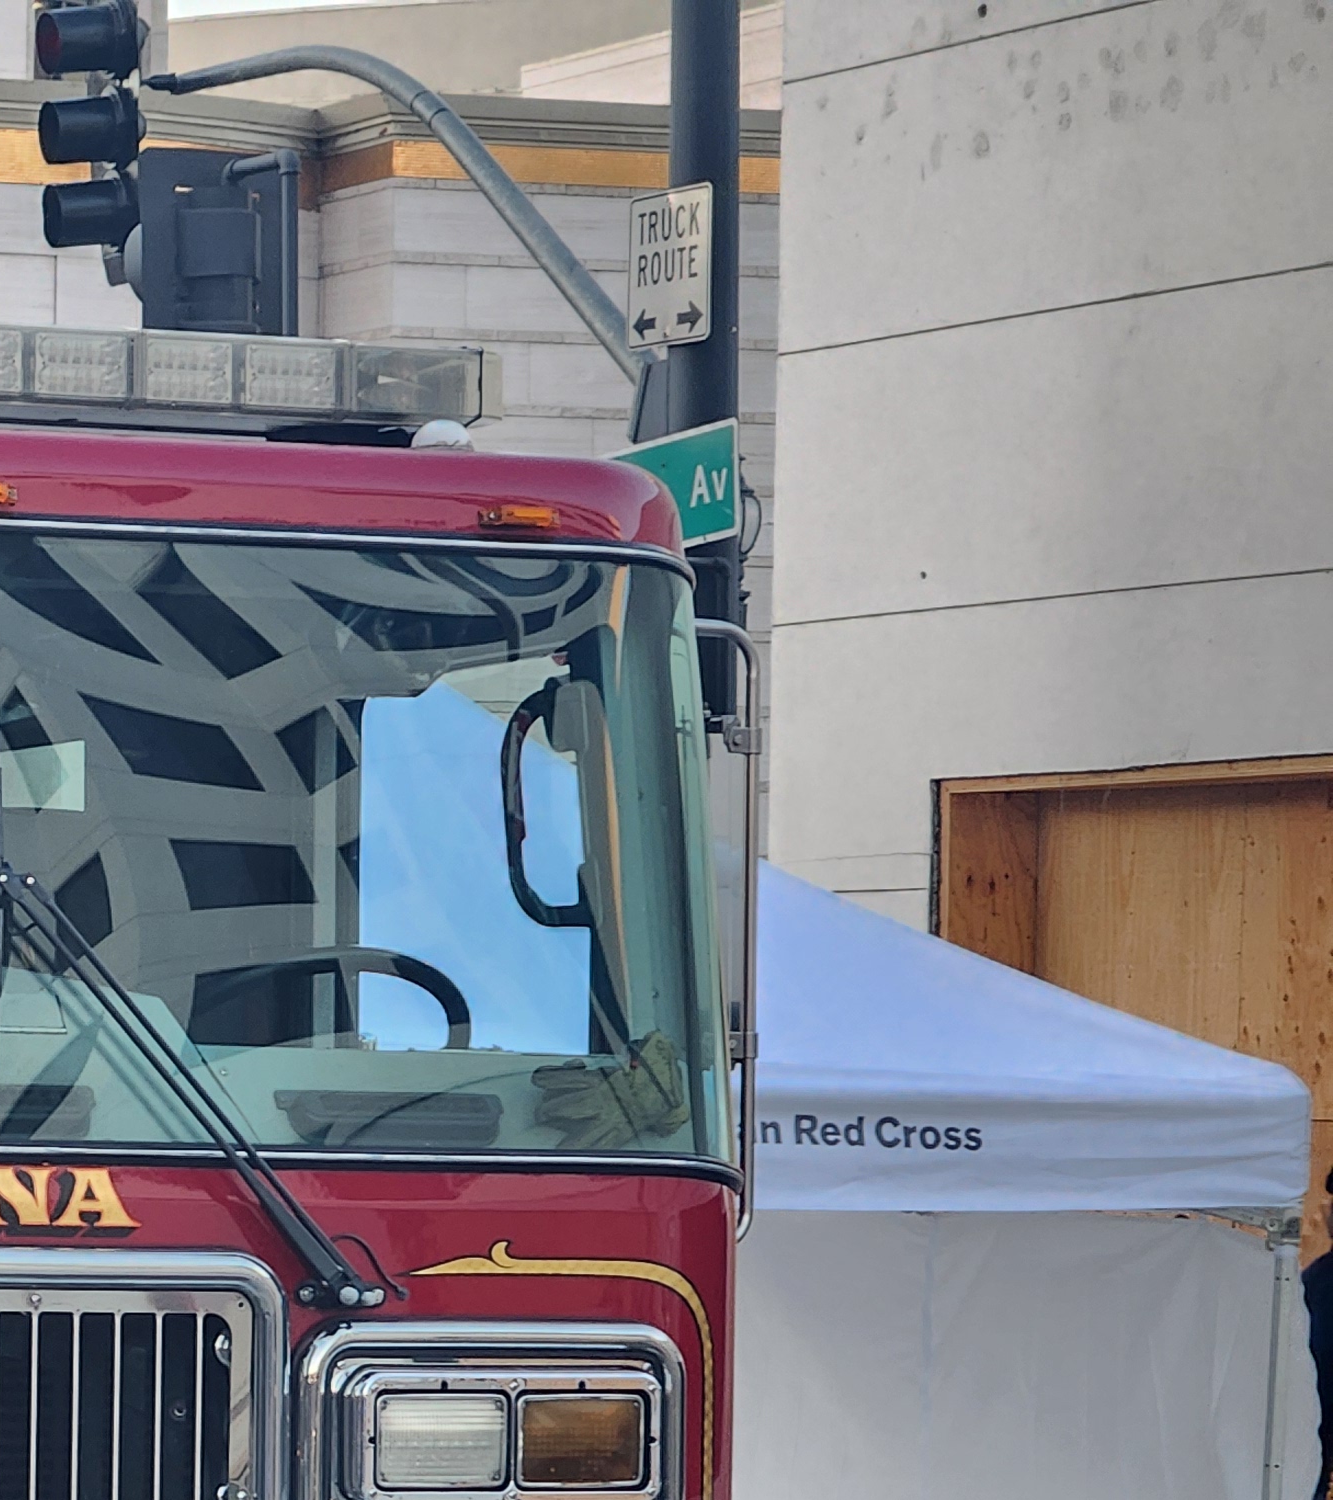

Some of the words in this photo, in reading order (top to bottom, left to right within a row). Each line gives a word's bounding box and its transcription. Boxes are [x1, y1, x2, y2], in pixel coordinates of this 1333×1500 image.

[638, 201, 700, 246] TRUCK
[637, 244, 698, 288] ROUTE
[794, 1113, 866, 1147] Red
[874, 1115, 983, 1151] Cross
